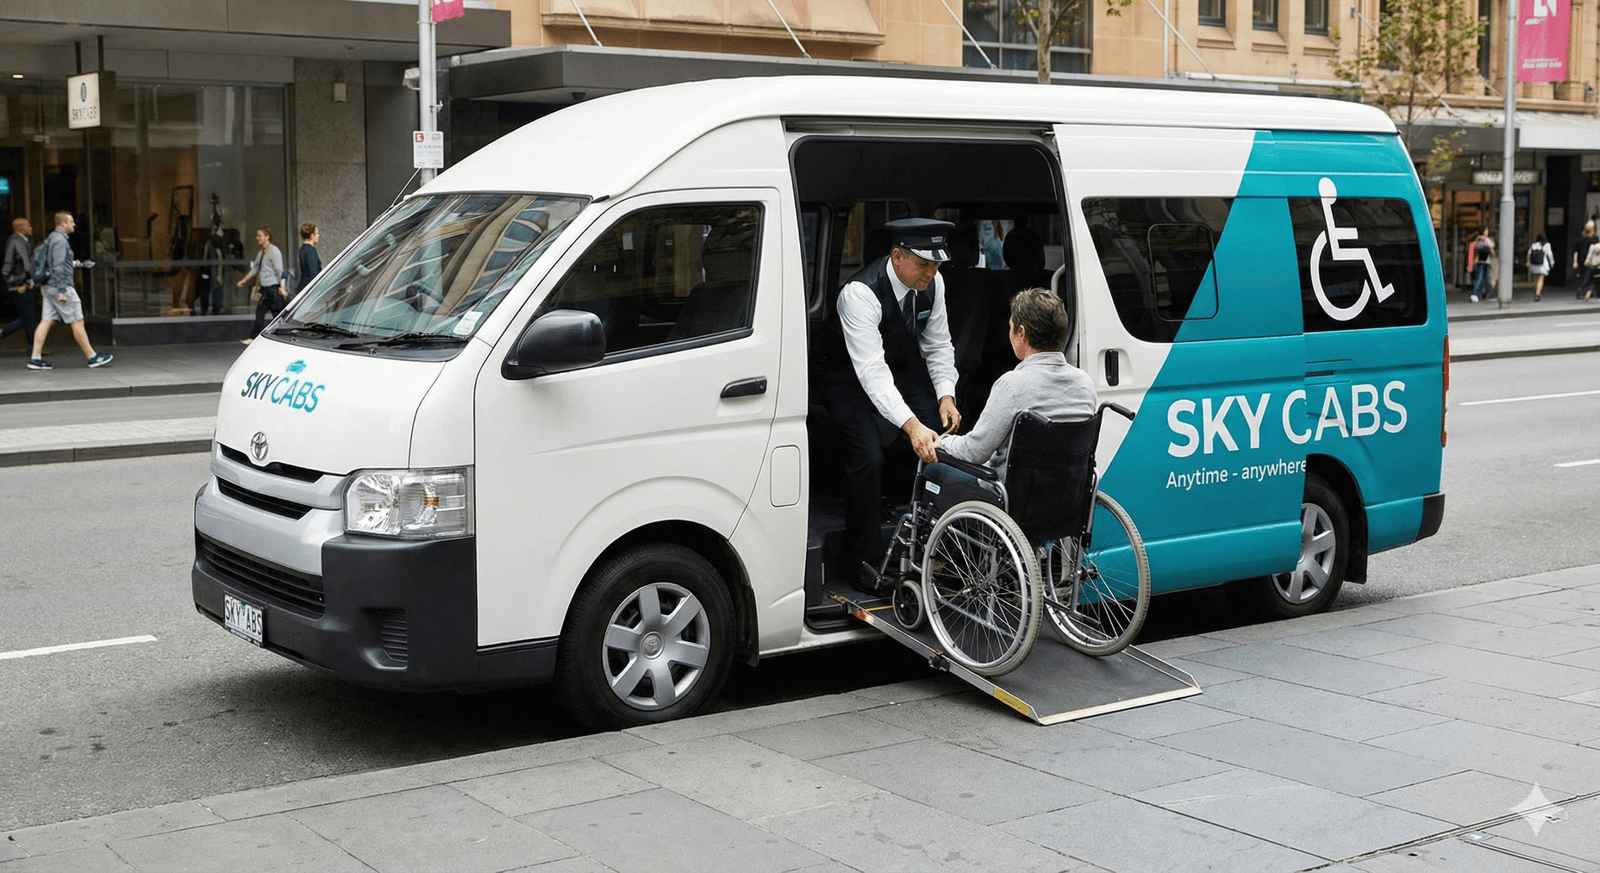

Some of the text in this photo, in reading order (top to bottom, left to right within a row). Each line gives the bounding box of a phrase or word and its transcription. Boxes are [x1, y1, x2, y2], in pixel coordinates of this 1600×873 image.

[1167, 380, 1408, 458] SKY CABS
[1166, 467, 1228, 491] Anytime
[1241, 458, 1307, 482] anywhere
